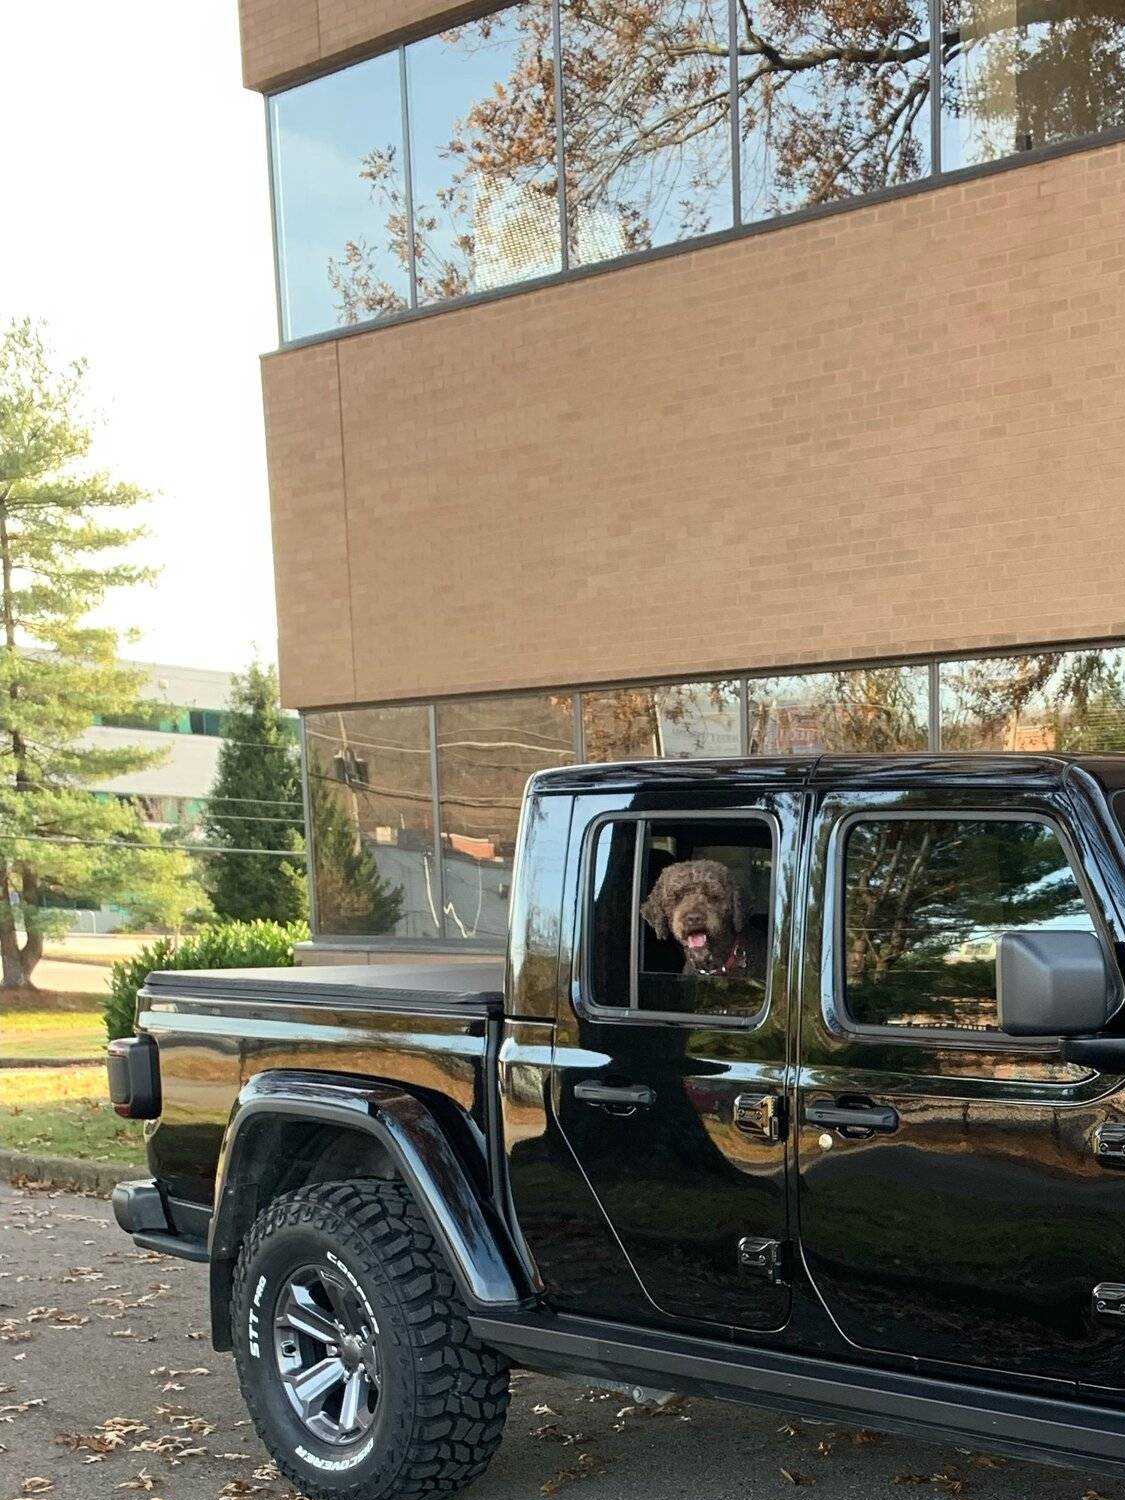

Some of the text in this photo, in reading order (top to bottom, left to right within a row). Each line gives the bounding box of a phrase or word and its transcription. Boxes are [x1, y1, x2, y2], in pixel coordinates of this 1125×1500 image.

[249, 1275, 267, 1359] STT PRO
[326, 1251, 380, 1335] COOPER
[295, 1437, 374, 1472] DISCOVERER
